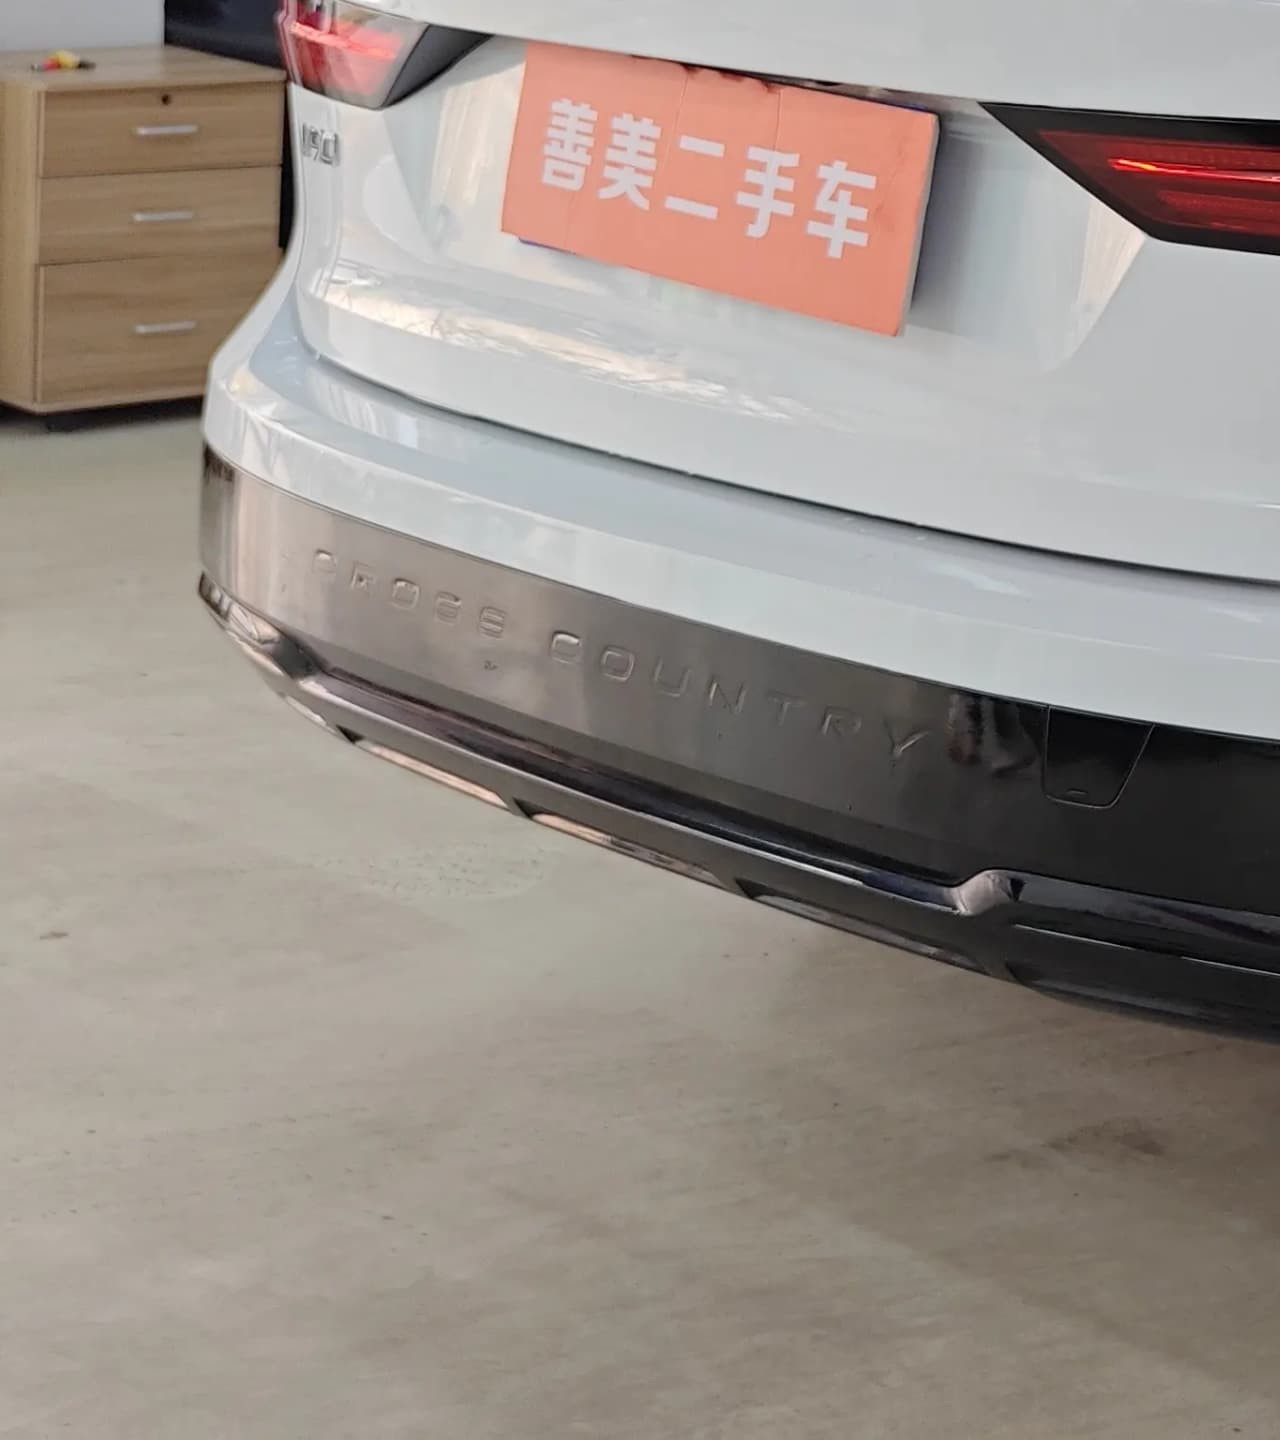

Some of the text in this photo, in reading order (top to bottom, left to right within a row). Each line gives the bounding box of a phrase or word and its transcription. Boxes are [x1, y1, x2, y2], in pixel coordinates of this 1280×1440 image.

[541, 97, 877, 260] 善美二手车
[550, 630, 930, 757] COUNTRY
